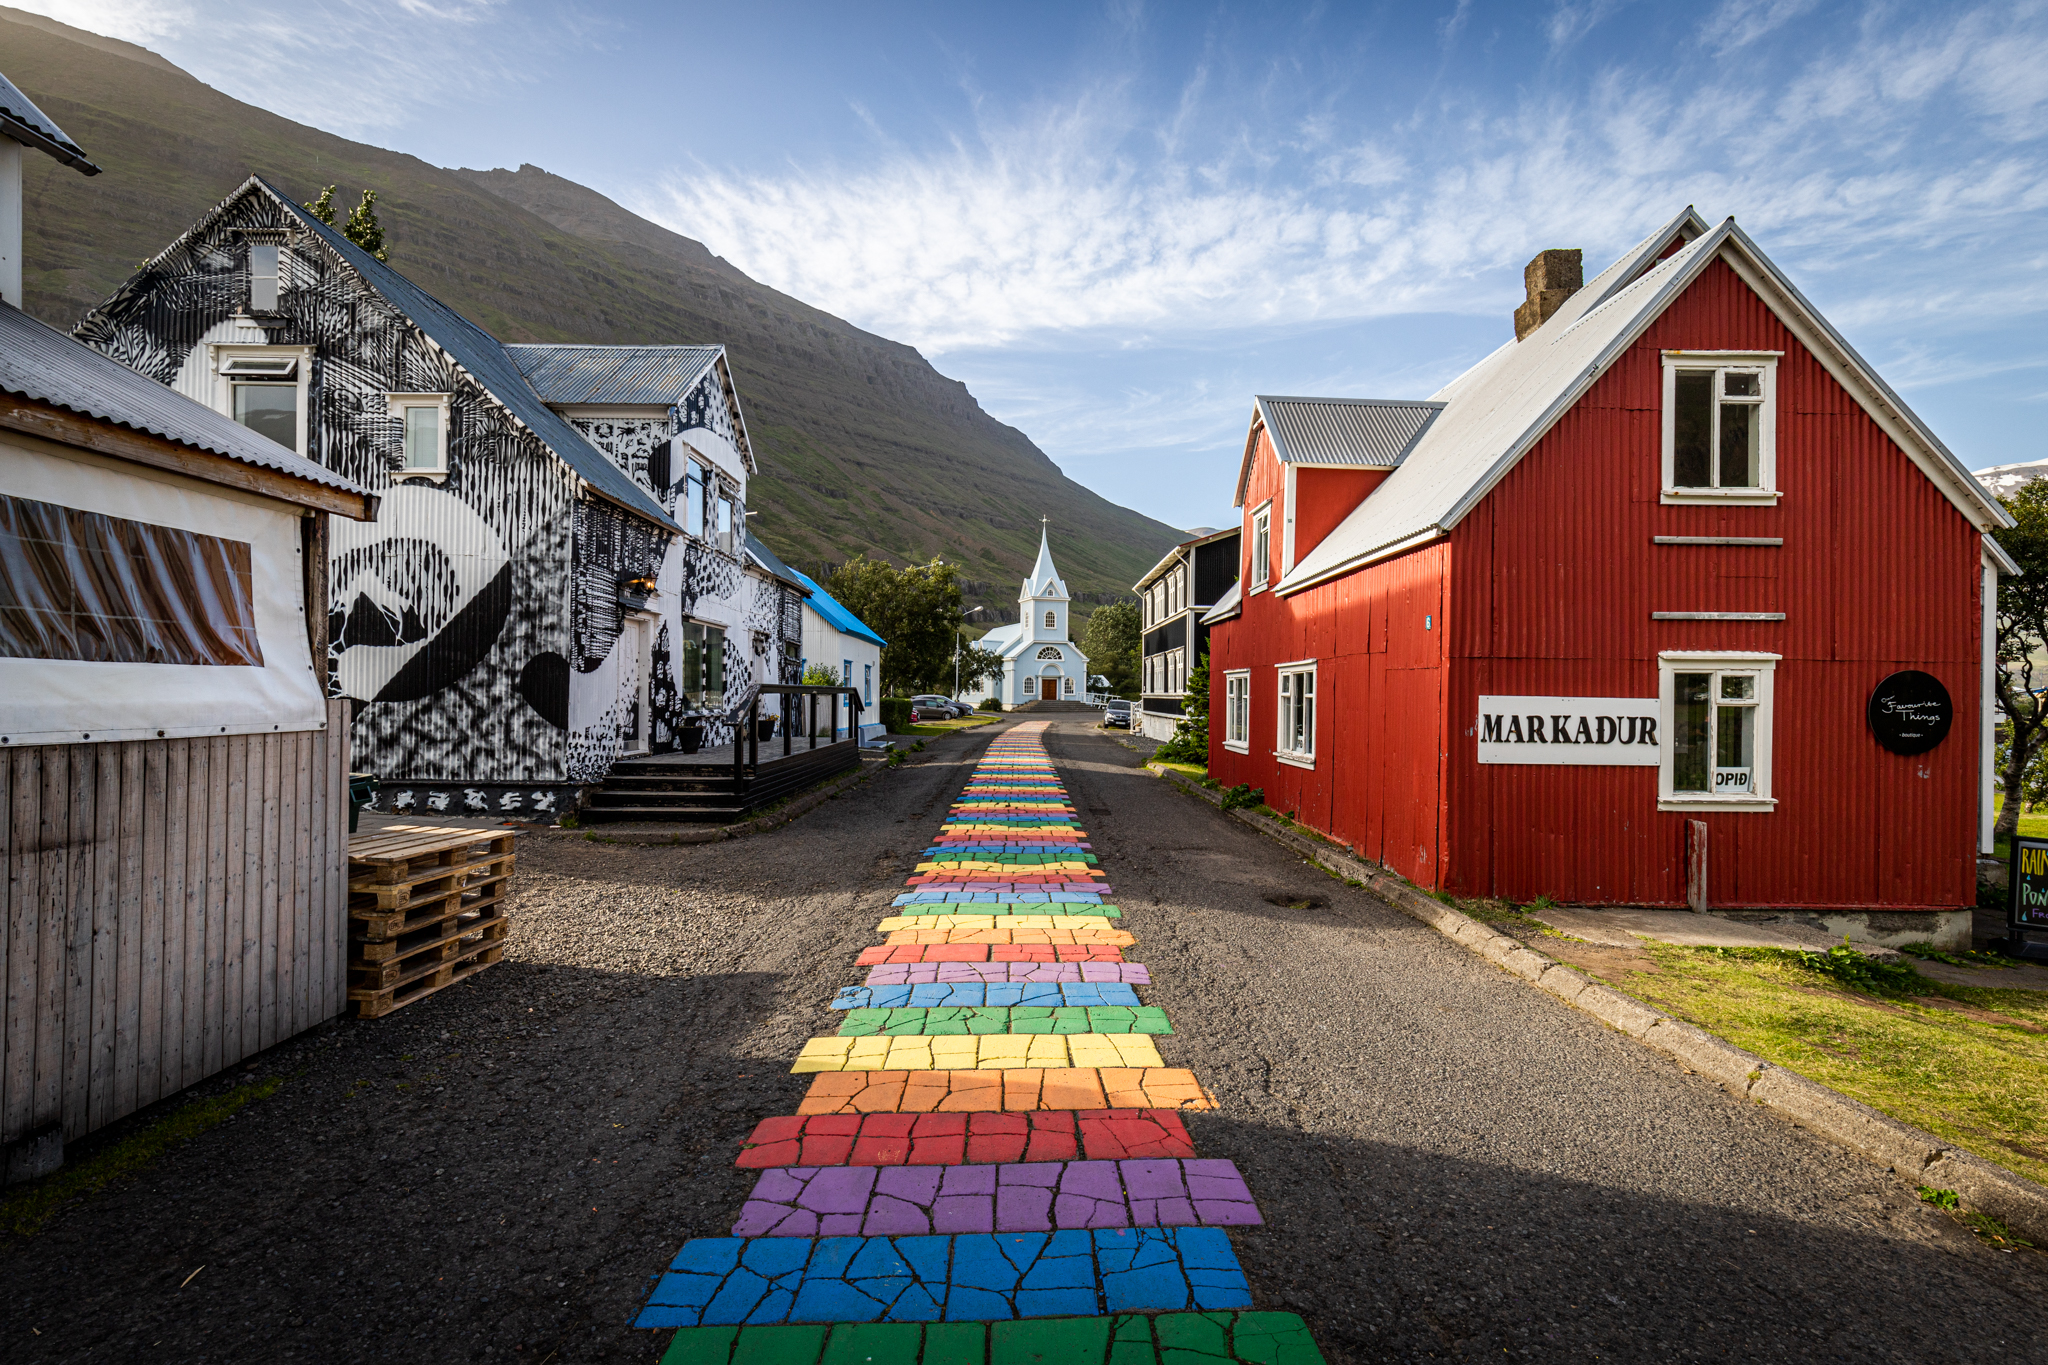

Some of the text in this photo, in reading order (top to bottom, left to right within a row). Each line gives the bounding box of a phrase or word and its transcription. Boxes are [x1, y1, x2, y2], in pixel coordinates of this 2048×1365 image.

[1882, 701, 1941, 713] Favourite
[1895, 709, 1940, 726] Things
[1481, 714, 1659, 746] MARKAÐUR
[1716, 772, 1747, 786] OPIÐ
